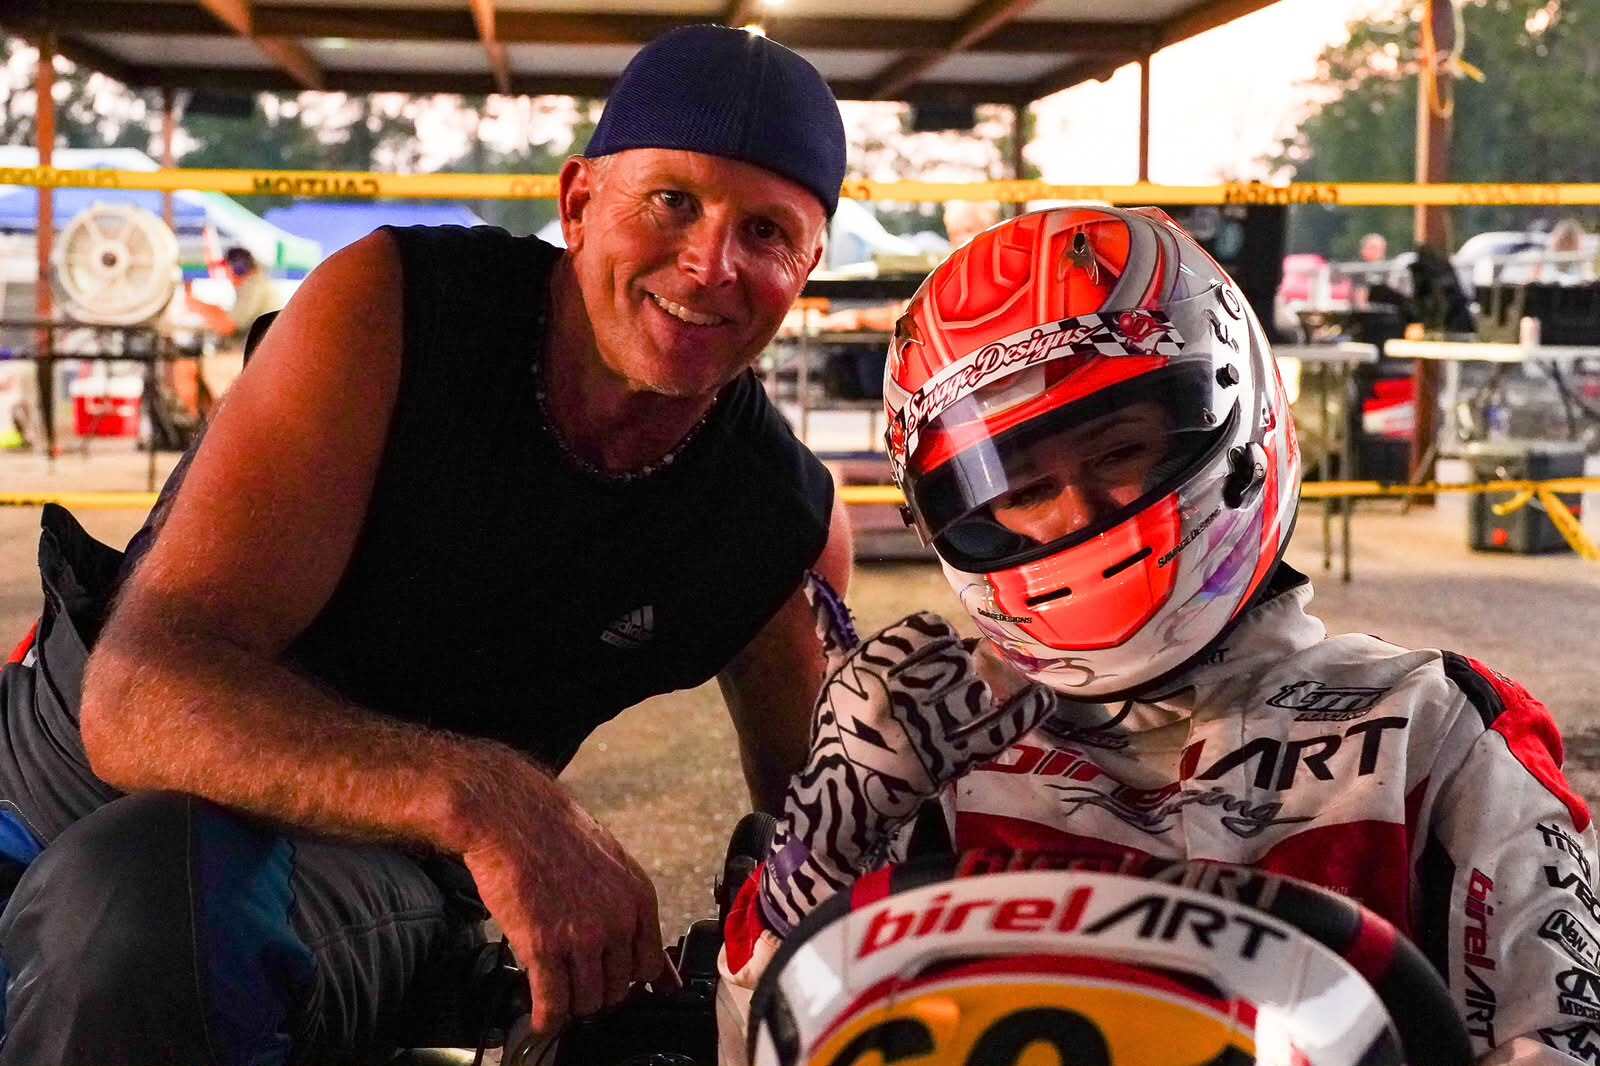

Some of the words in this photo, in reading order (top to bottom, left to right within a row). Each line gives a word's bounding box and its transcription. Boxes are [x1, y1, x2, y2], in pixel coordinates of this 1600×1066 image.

[975, 329, 1095, 376] Designs
[856, 886, 1288, 960] birelART
[1464, 867, 1497, 1049] birelART
